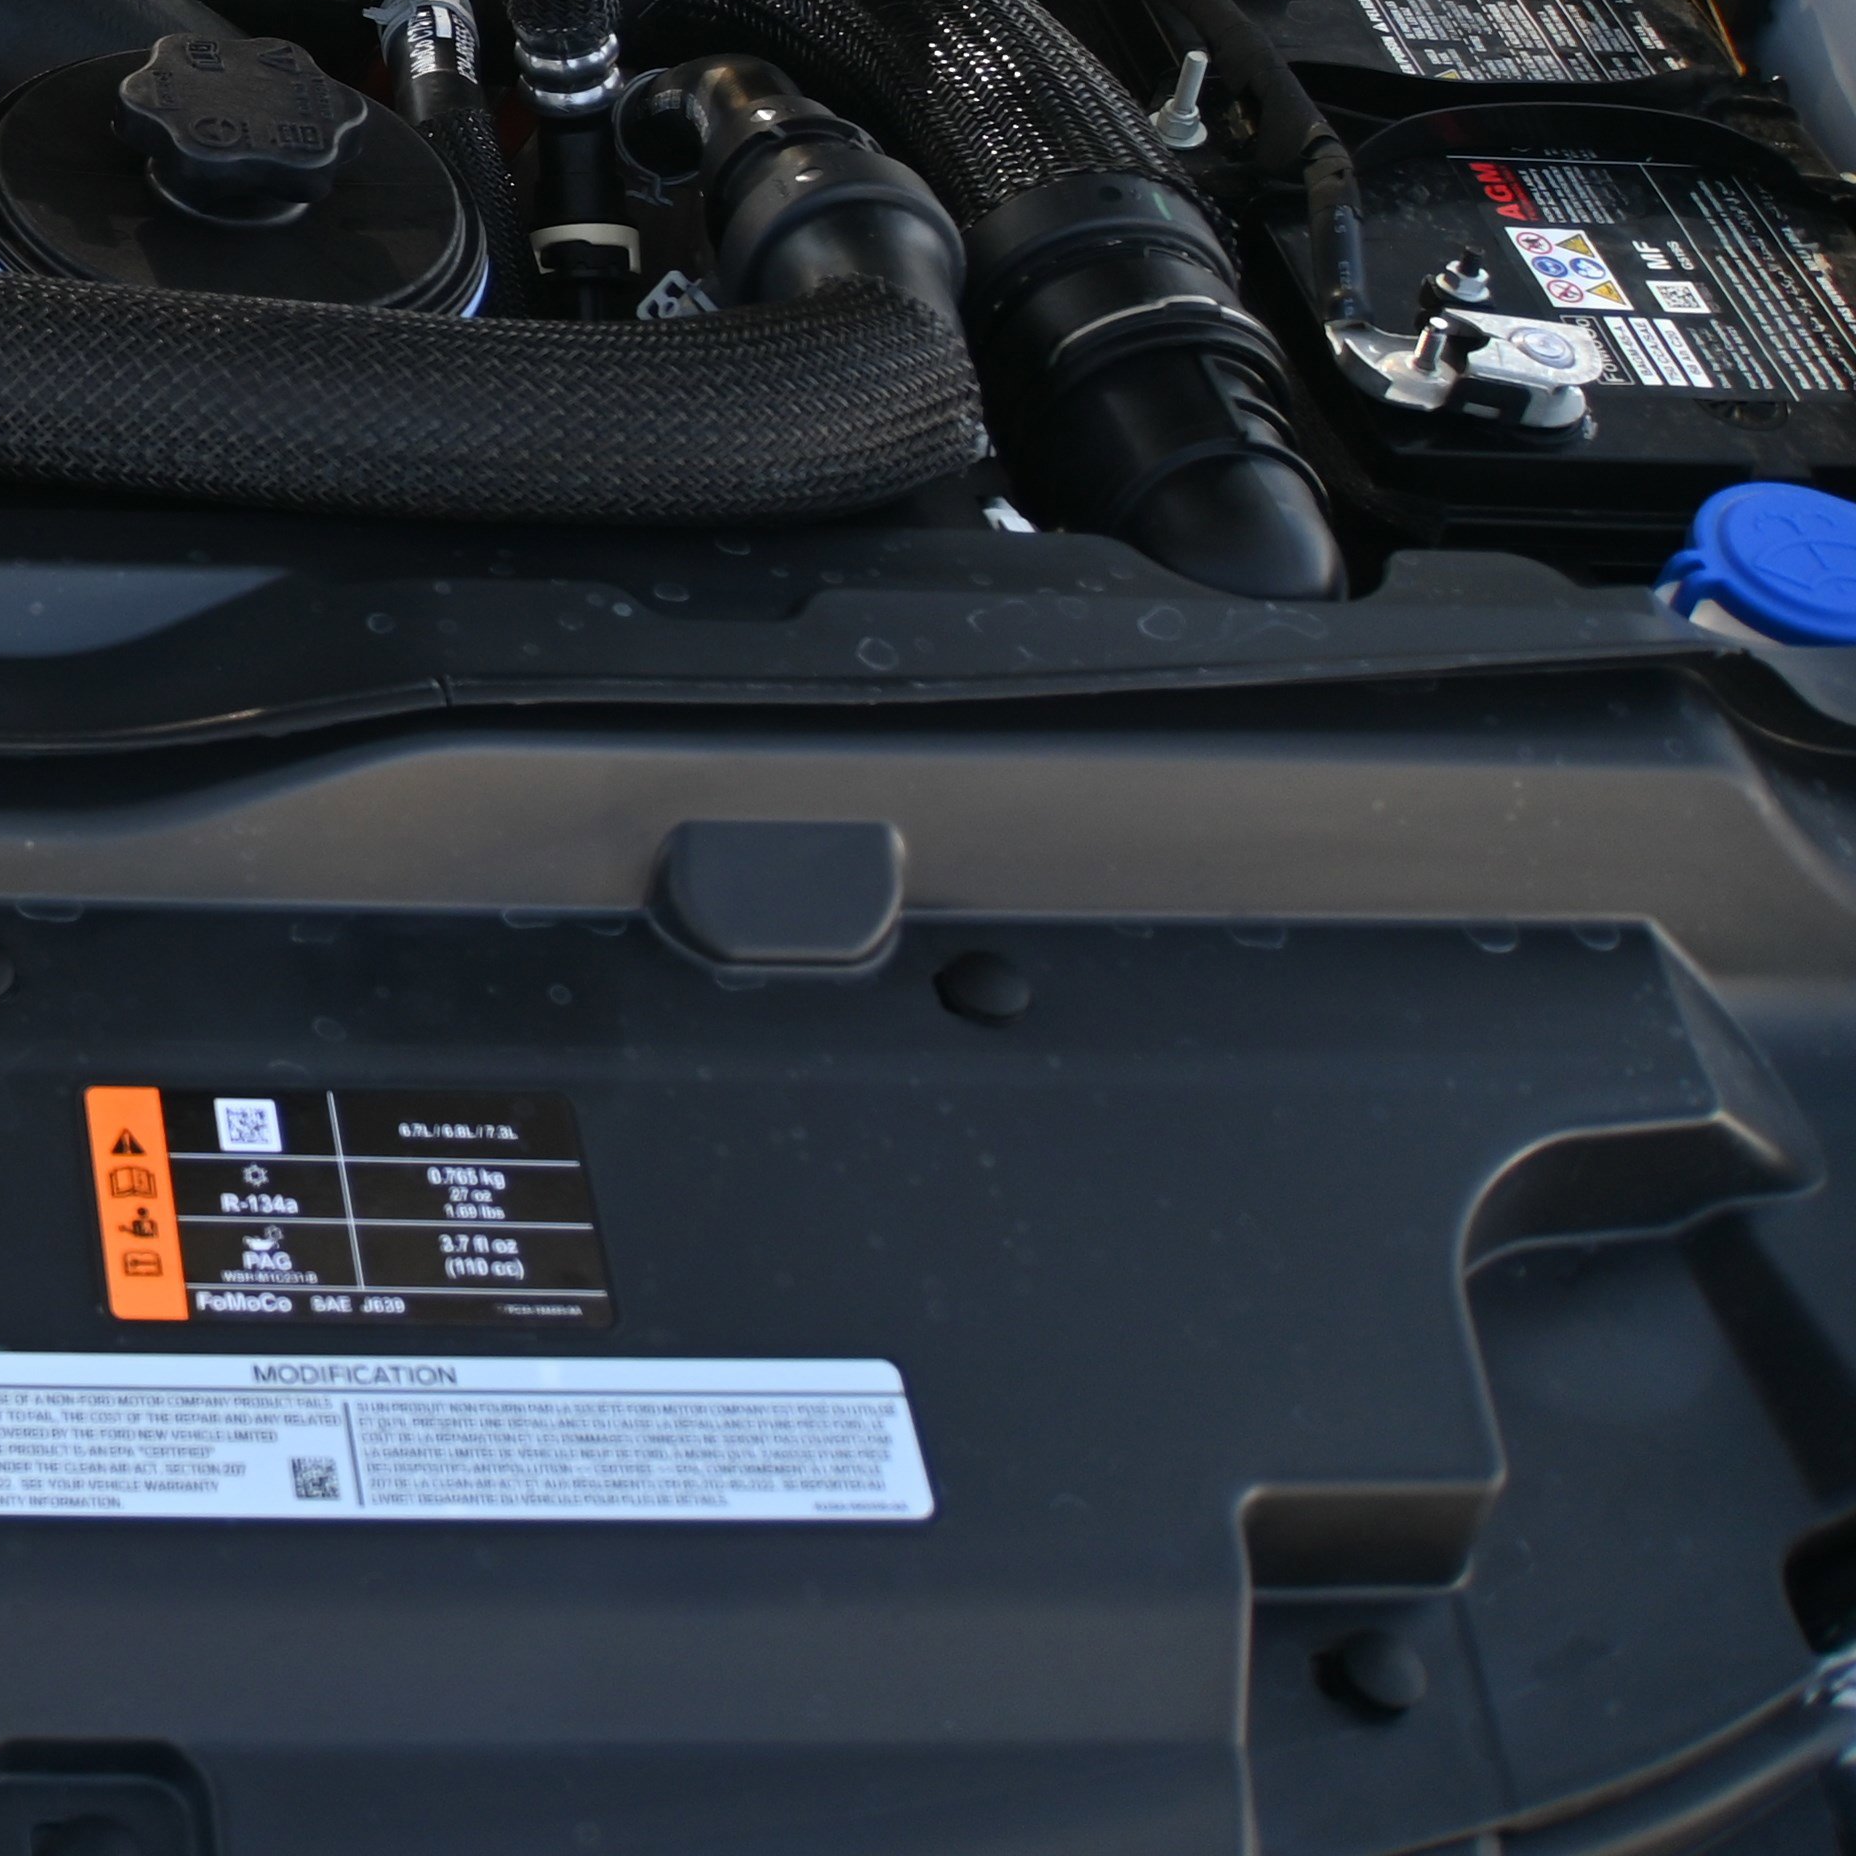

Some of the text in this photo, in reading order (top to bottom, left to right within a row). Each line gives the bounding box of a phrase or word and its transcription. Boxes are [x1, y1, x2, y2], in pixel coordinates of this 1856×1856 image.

[1470, 160, 1528, 221] AGM
[1630, 239, 1673, 269] MF
[481, 1169, 507, 1190] kg
[220, 1193, 299, 1215] R-134a
[448, 1187, 493, 1203] 27 oz
[480, 1205, 506, 1220] lbs
[438, 1234, 469, 1253] 3.7
[491, 1238, 519, 1254] oz
[242, 1251, 293, 1271] PAG
[444, 1257, 525, 1280] (110 cc)
[195, 1291, 293, 1313] FoMoCo
[309, 1295, 353, 1314] SAE
[252, 1363, 458, 1386] MODIFICATION
